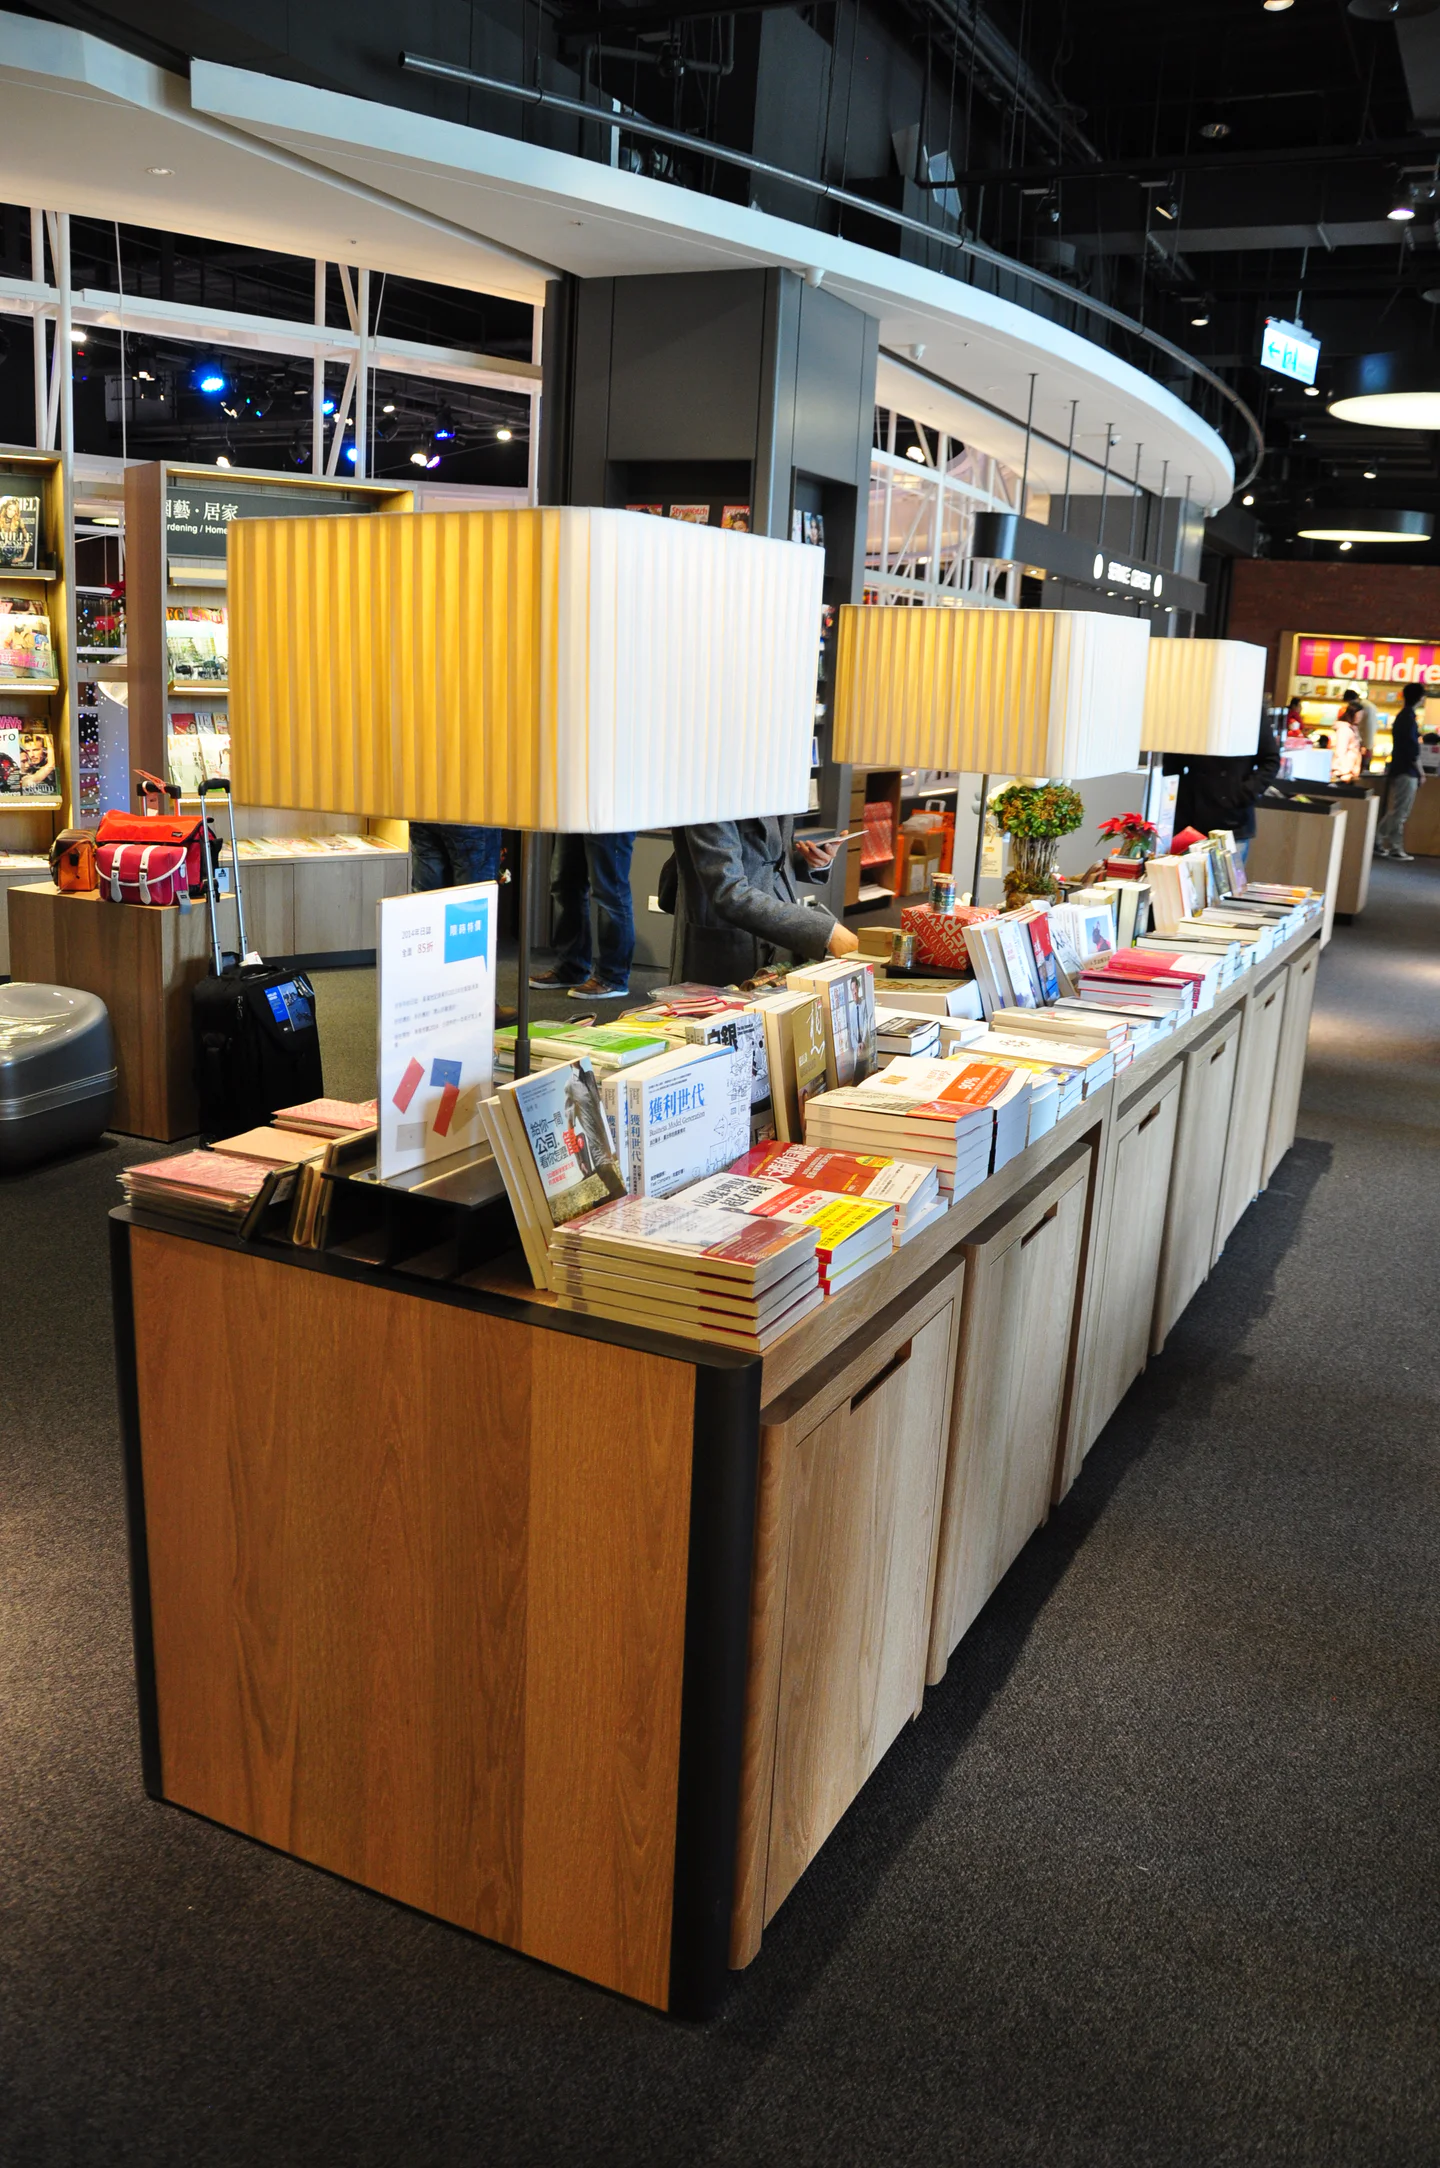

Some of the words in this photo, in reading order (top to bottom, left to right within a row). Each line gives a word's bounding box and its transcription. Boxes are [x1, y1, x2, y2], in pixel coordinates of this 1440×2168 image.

[166, 522, 198, 535] rdening
[1332, 652, 1440, 684] Childre
[449, 920, 482, 936] 限時特價
[649, 1083, 706, 1124] 獲利世代
[530, 1110, 563, 1137] 給你一間
[630, 1115, 642, 1162] 獲利世代
